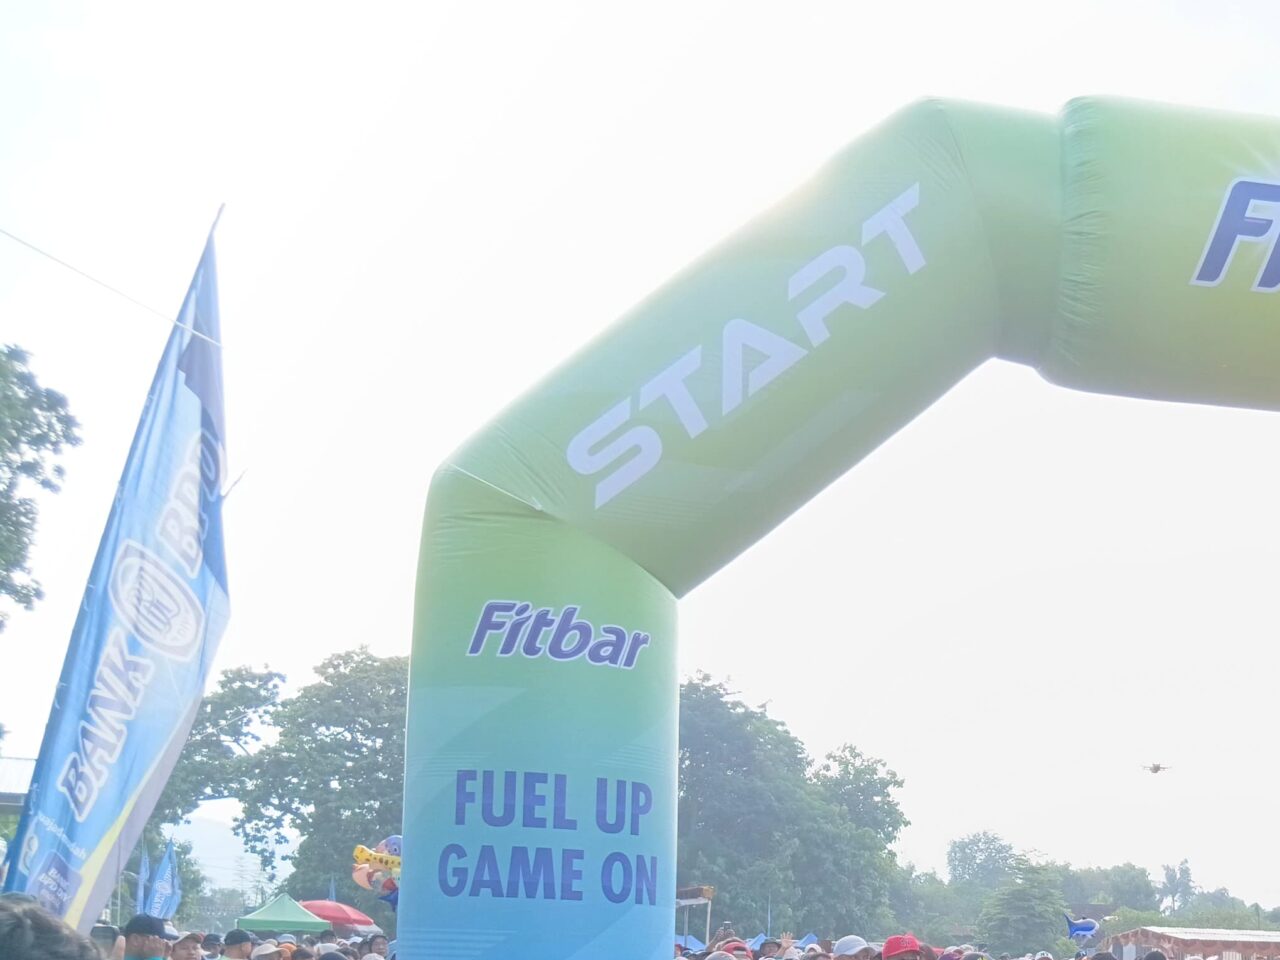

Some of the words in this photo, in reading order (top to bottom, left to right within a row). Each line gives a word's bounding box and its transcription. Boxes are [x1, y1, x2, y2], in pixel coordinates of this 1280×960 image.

[566, 181, 926, 510] START
[467, 599, 651, 669] Fitbar
[56, 626, 156, 822] BANK
[455, 769, 578, 830] FUEL
[595, 777, 653, 836] UP
[438, 843, 585, 901] GAME
[601, 851, 657, 906] ON
